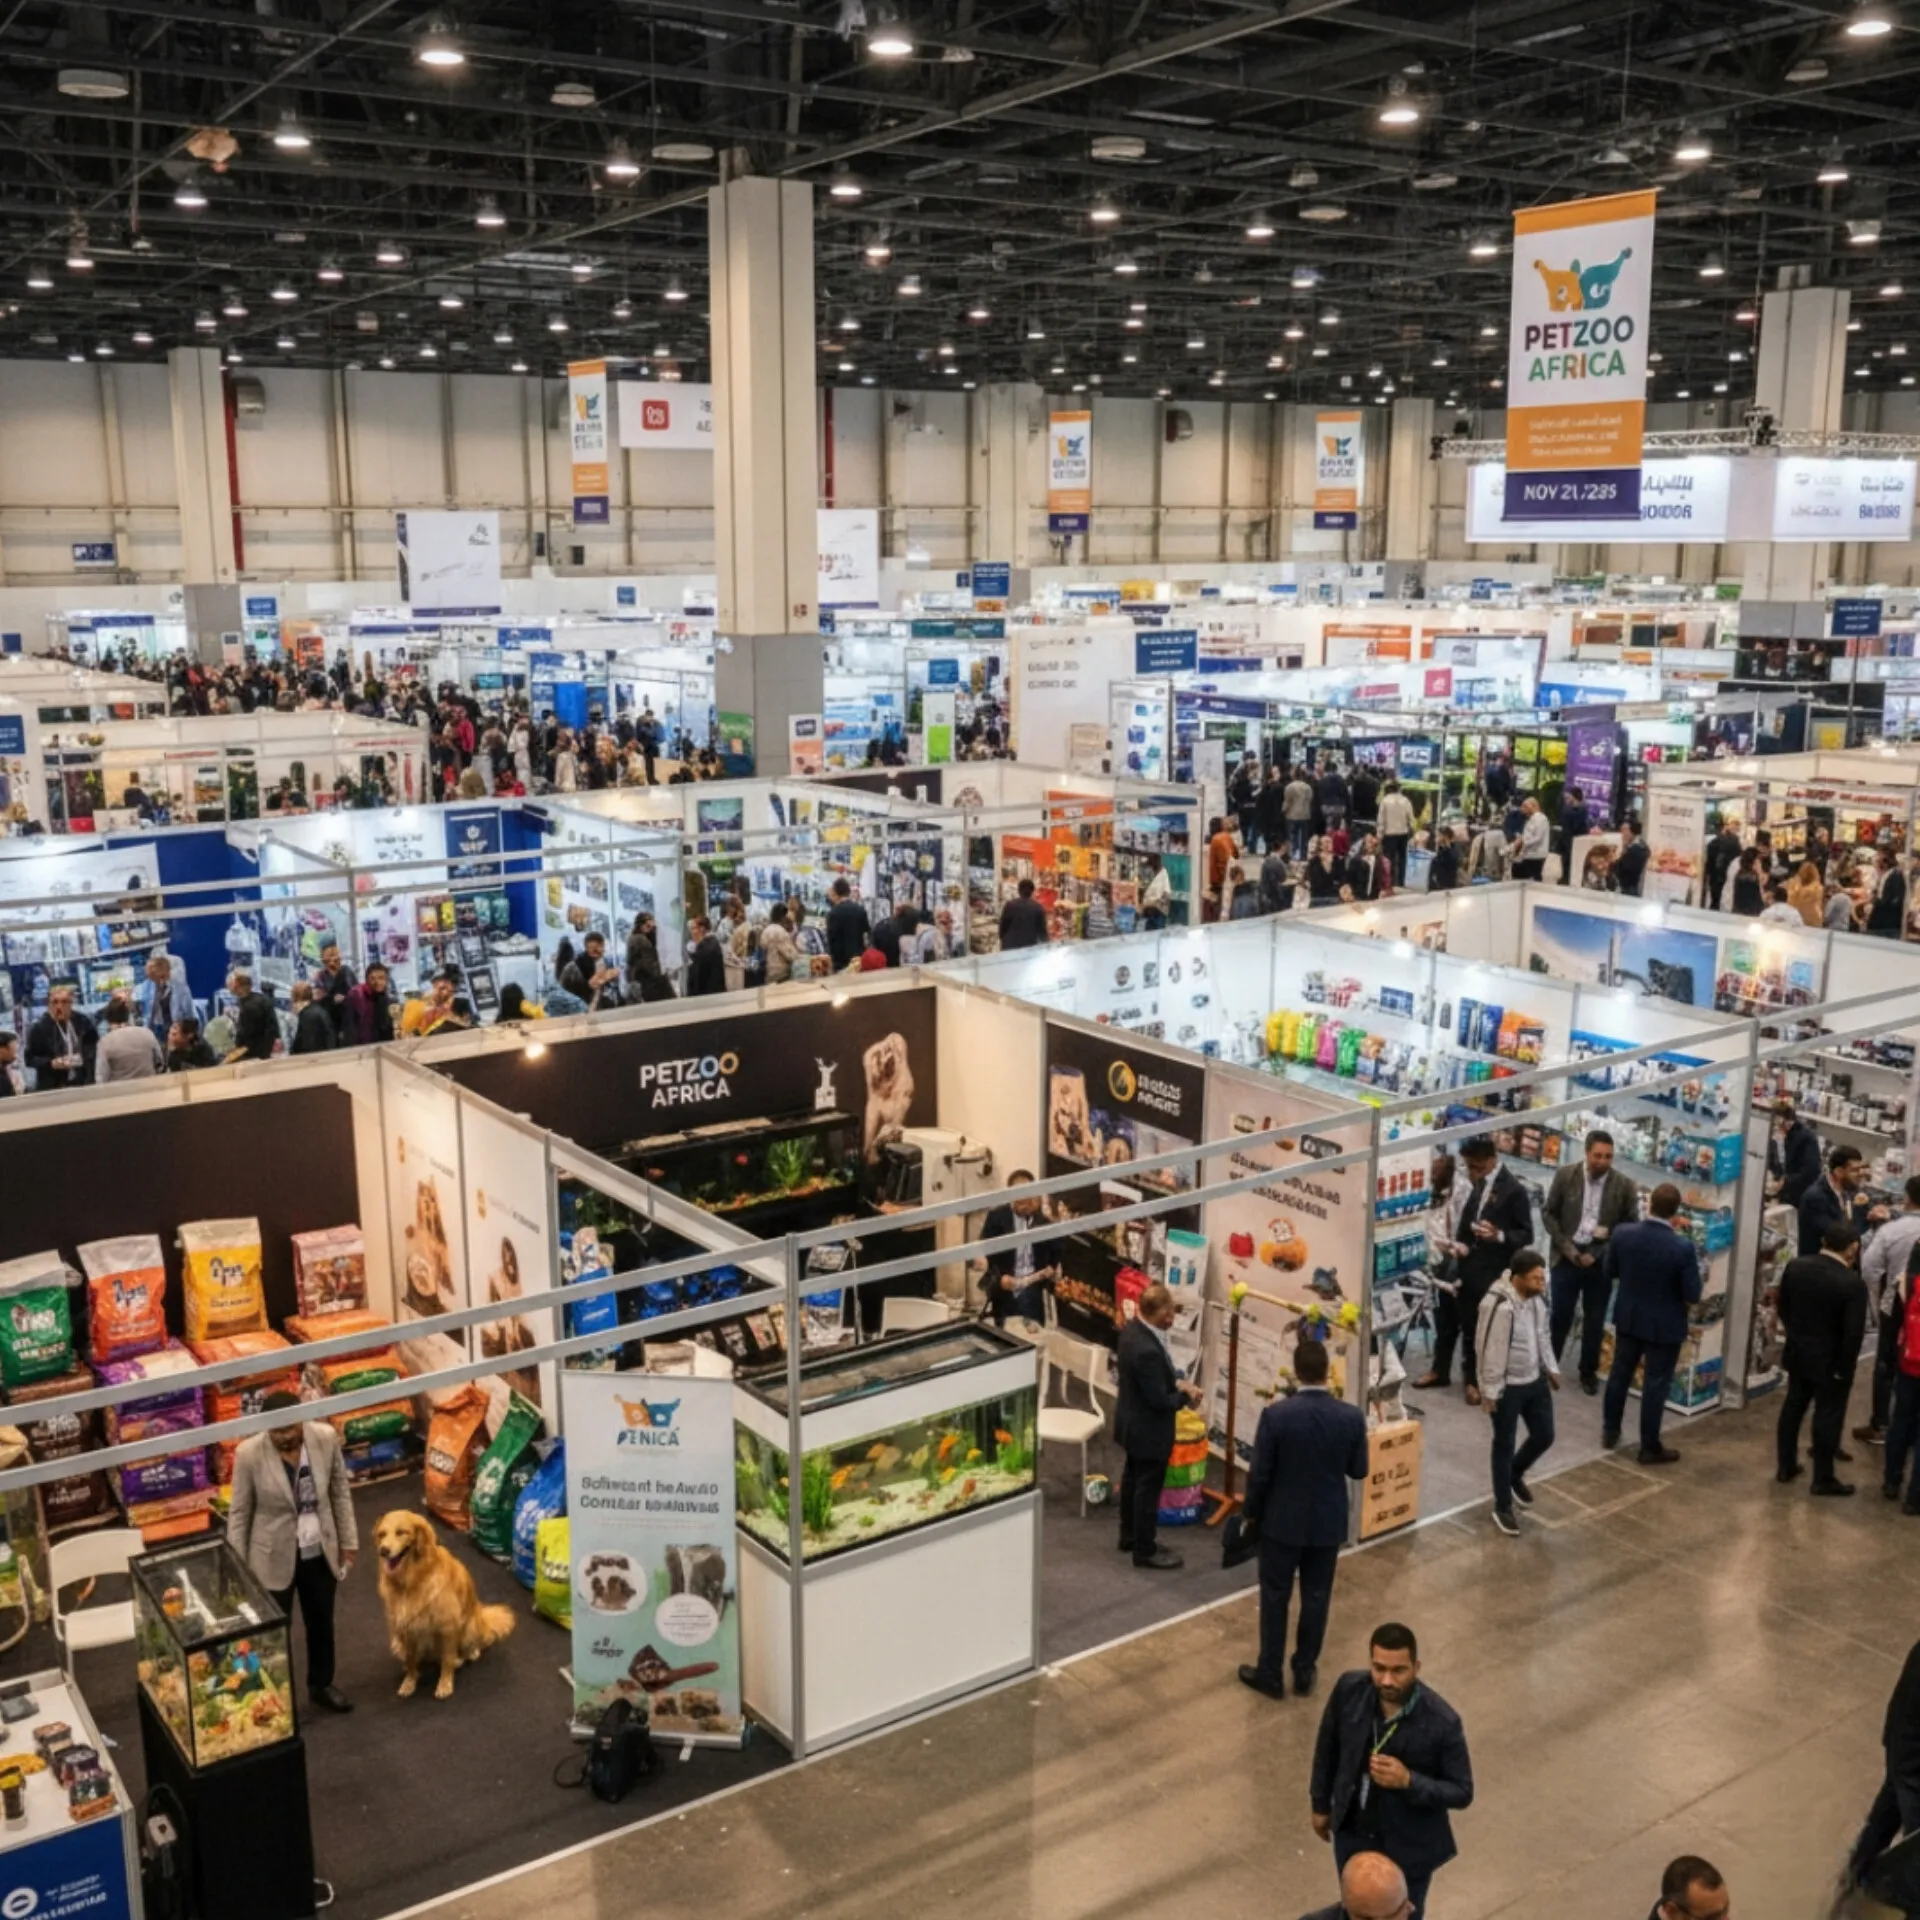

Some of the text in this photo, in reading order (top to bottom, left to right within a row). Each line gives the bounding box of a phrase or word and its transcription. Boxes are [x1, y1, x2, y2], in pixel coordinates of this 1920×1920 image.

[1525, 315, 1634, 352] PETZOO
[1528, 349, 1626, 382] AFRICA
[1524, 484, 1558, 501] NOV
[640, 1051, 739, 1089] PETZOO
[651, 1076, 731, 1109] AFRICA
